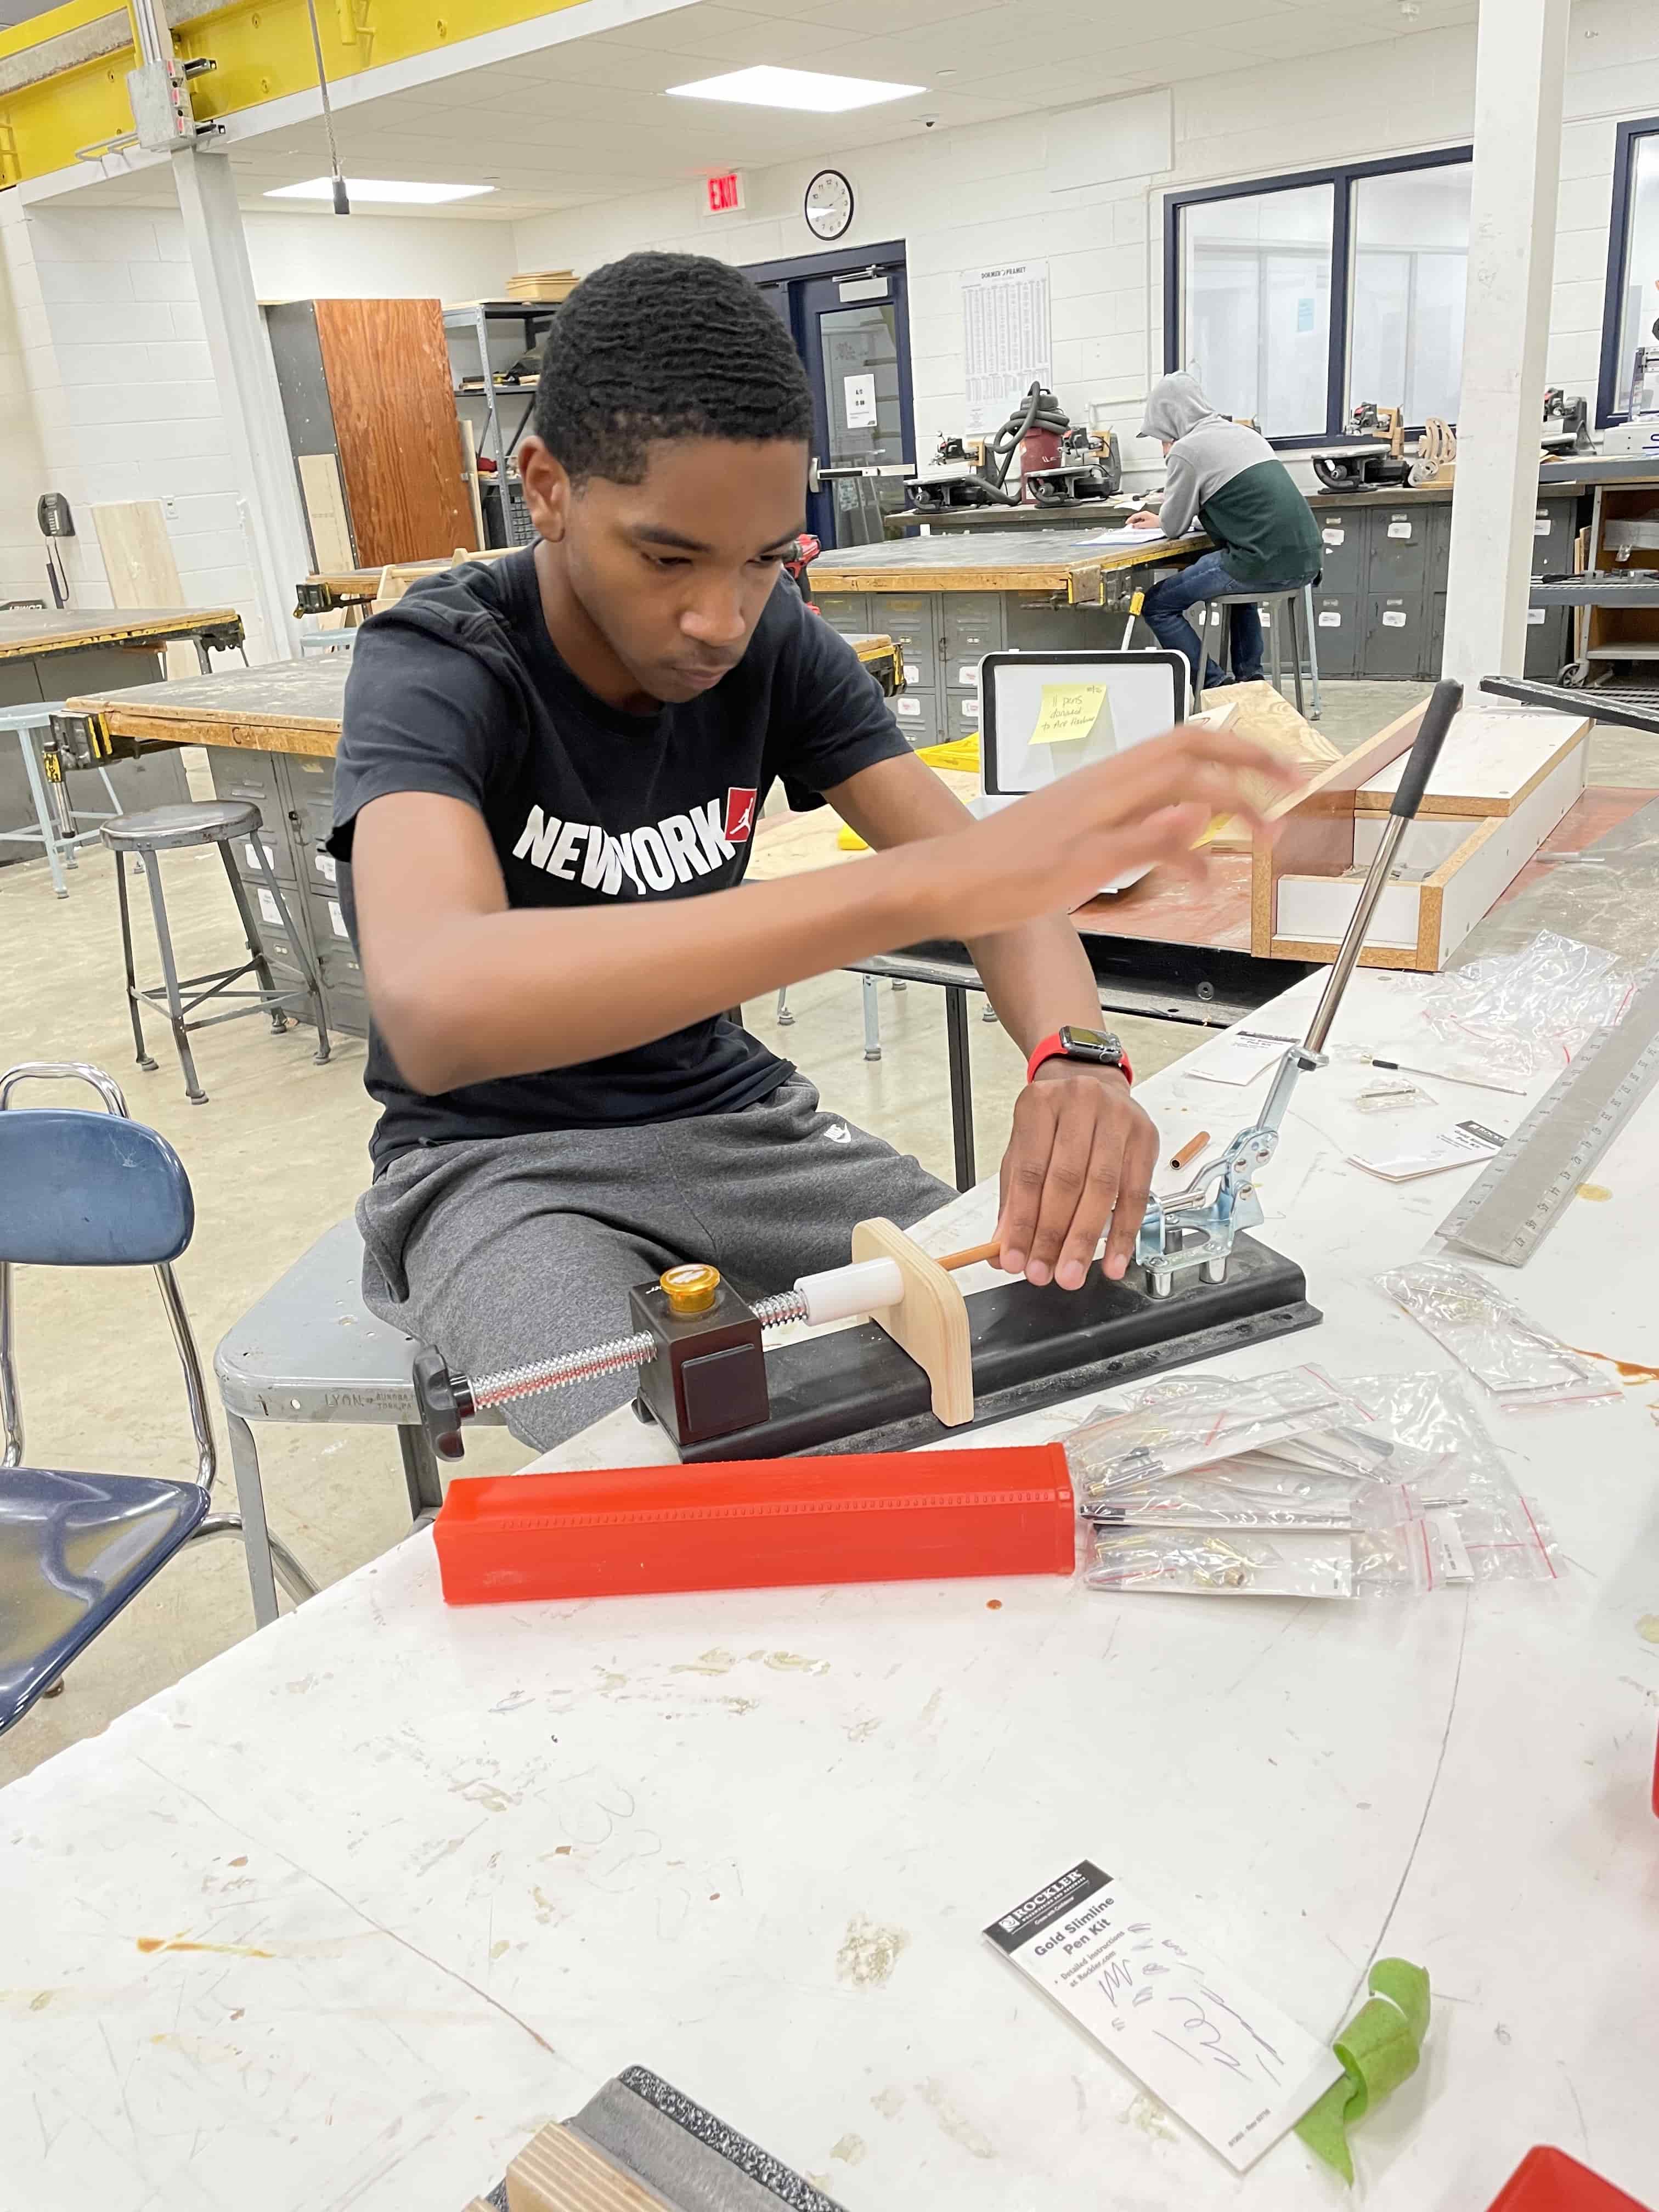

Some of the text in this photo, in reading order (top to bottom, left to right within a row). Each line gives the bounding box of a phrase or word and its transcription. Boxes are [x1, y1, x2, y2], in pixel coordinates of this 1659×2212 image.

[709, 175, 738, 211] EXIT
[512, 798, 736, 896] NEW YORK
[1012, 1869, 1082, 1920] ROCKLER
[1035, 1897, 1115, 1956] Gold Slimline
[1063, 1918, 1110, 1955] Pen Kit
[1060, 1931, 1125, 1980] Detailed instructions
[1070, 1979, 1079, 1988] at
[1077, 1950, 1116, 1981] Rockler.com
